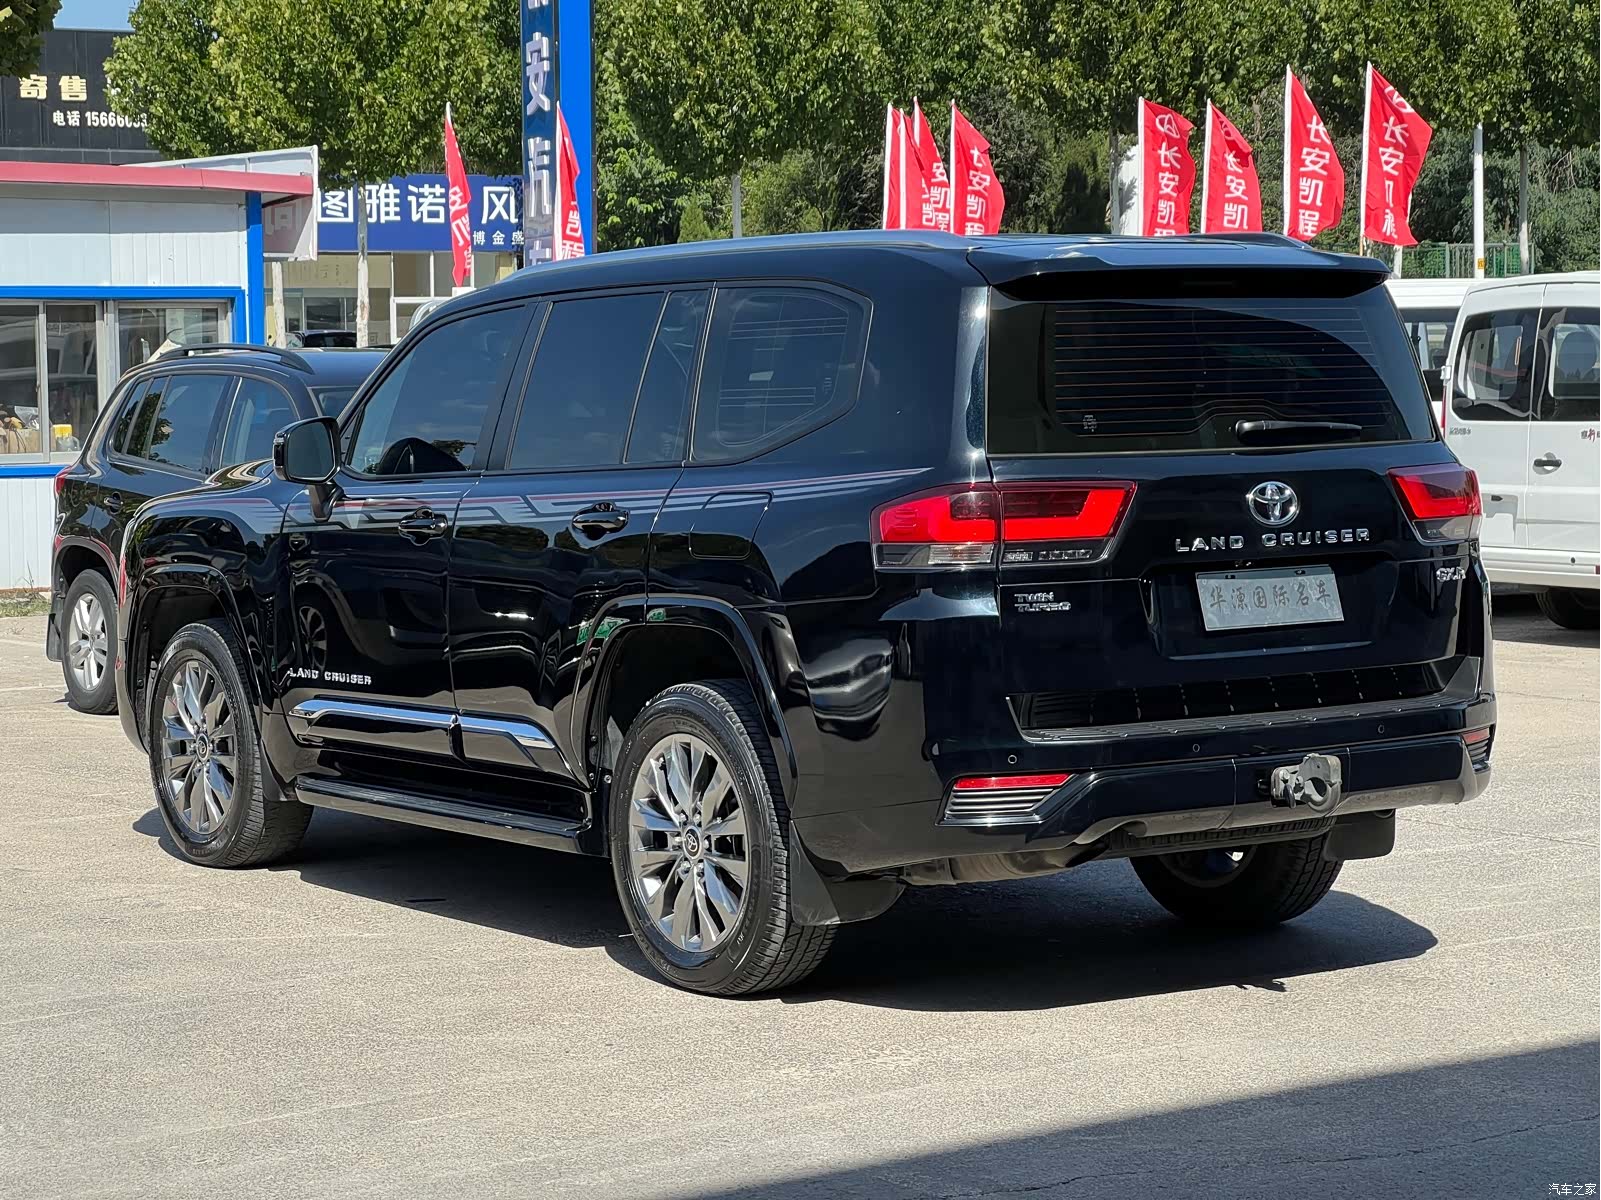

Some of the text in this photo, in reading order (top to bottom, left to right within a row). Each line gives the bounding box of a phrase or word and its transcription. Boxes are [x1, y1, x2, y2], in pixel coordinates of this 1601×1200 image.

[19, 74, 87, 101] 寄售
[53, 110, 80, 127] 电话
[1298, 115, 1331, 237] 长安凯程
[1223, 150, 1248, 230] 长安凯
[317, 183, 446, 225] 图雅诺
[481, 186, 519, 225] 风
[473, 230, 525, 246] 博金盛
[1175, 528, 1370, 552] LAND CRUISER
[1014, 592, 1054, 602] TWIN
[1014, 601, 1072, 612] TURBO
[1210, 579, 1332, 613] 华源国际名车
[289, 667, 372, 685] LAND CRUISER
